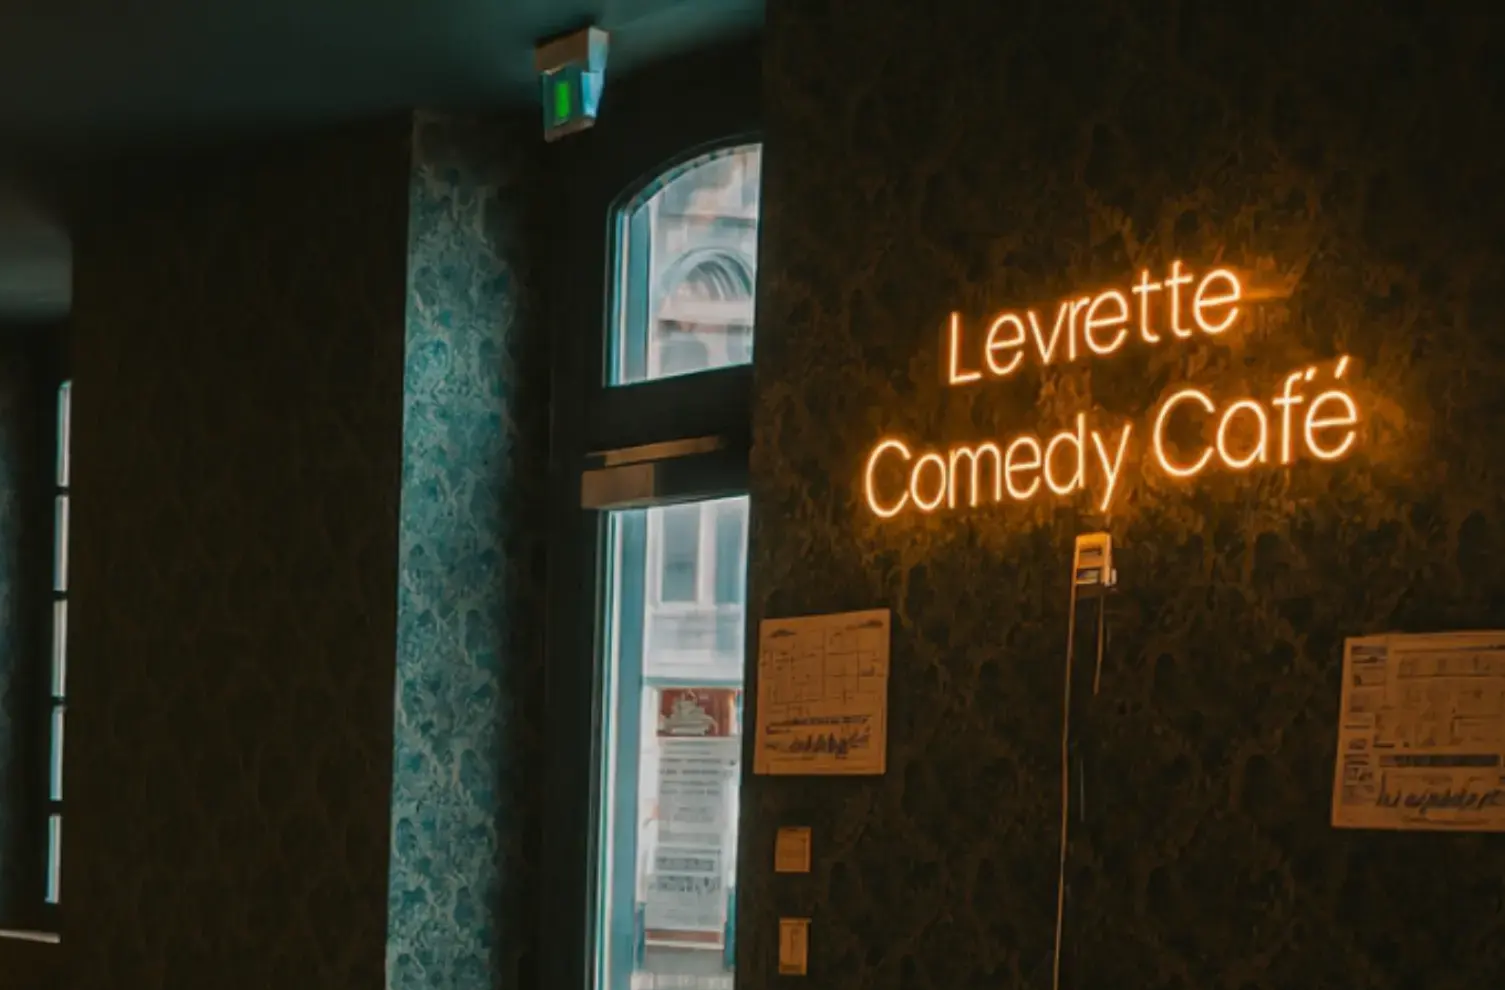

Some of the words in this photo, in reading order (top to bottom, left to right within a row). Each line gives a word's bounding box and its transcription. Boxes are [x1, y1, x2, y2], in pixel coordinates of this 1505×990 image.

[948, 260, 1242, 386] Levrette
[864, 412, 1133, 519] Comedy
[1152, 355, 1359, 478] Café
